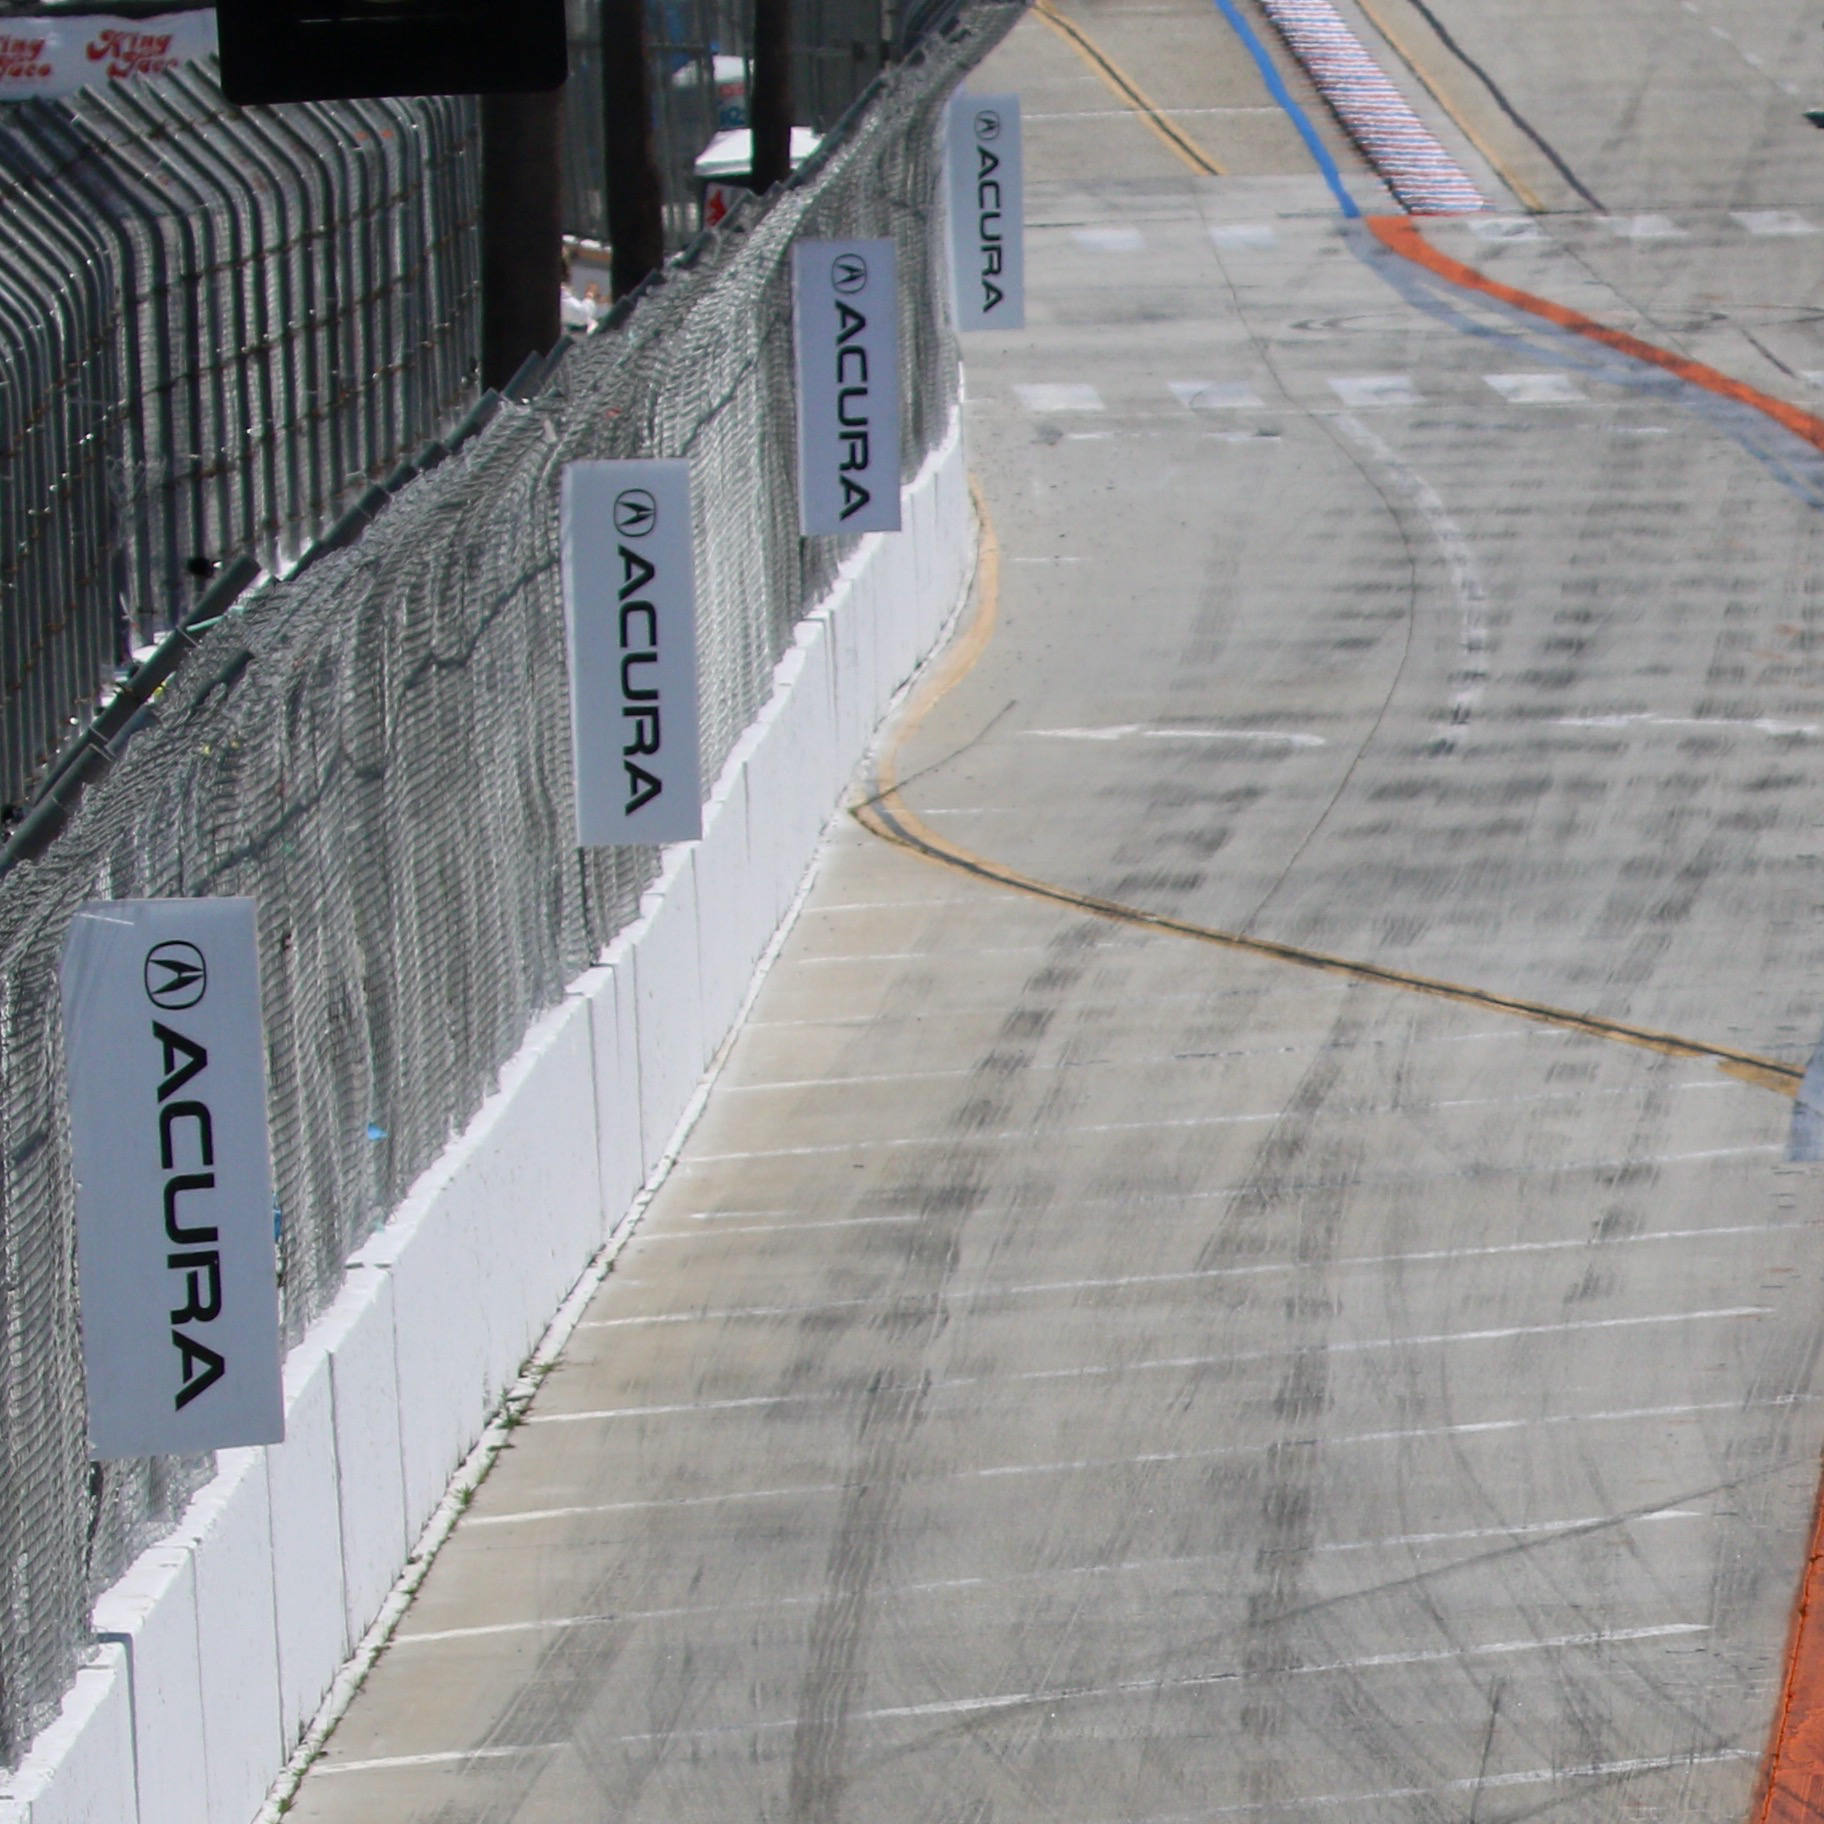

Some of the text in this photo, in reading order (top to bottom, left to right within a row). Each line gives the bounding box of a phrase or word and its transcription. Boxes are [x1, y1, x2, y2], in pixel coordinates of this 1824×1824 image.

[0, 36, 45, 61] ing
[976, 148, 1004, 314] ACURA
[833, 301, 872, 522] ACURA
[617, 545, 663, 815] ACURA
[152, 1020, 225, 1411] ACURA
